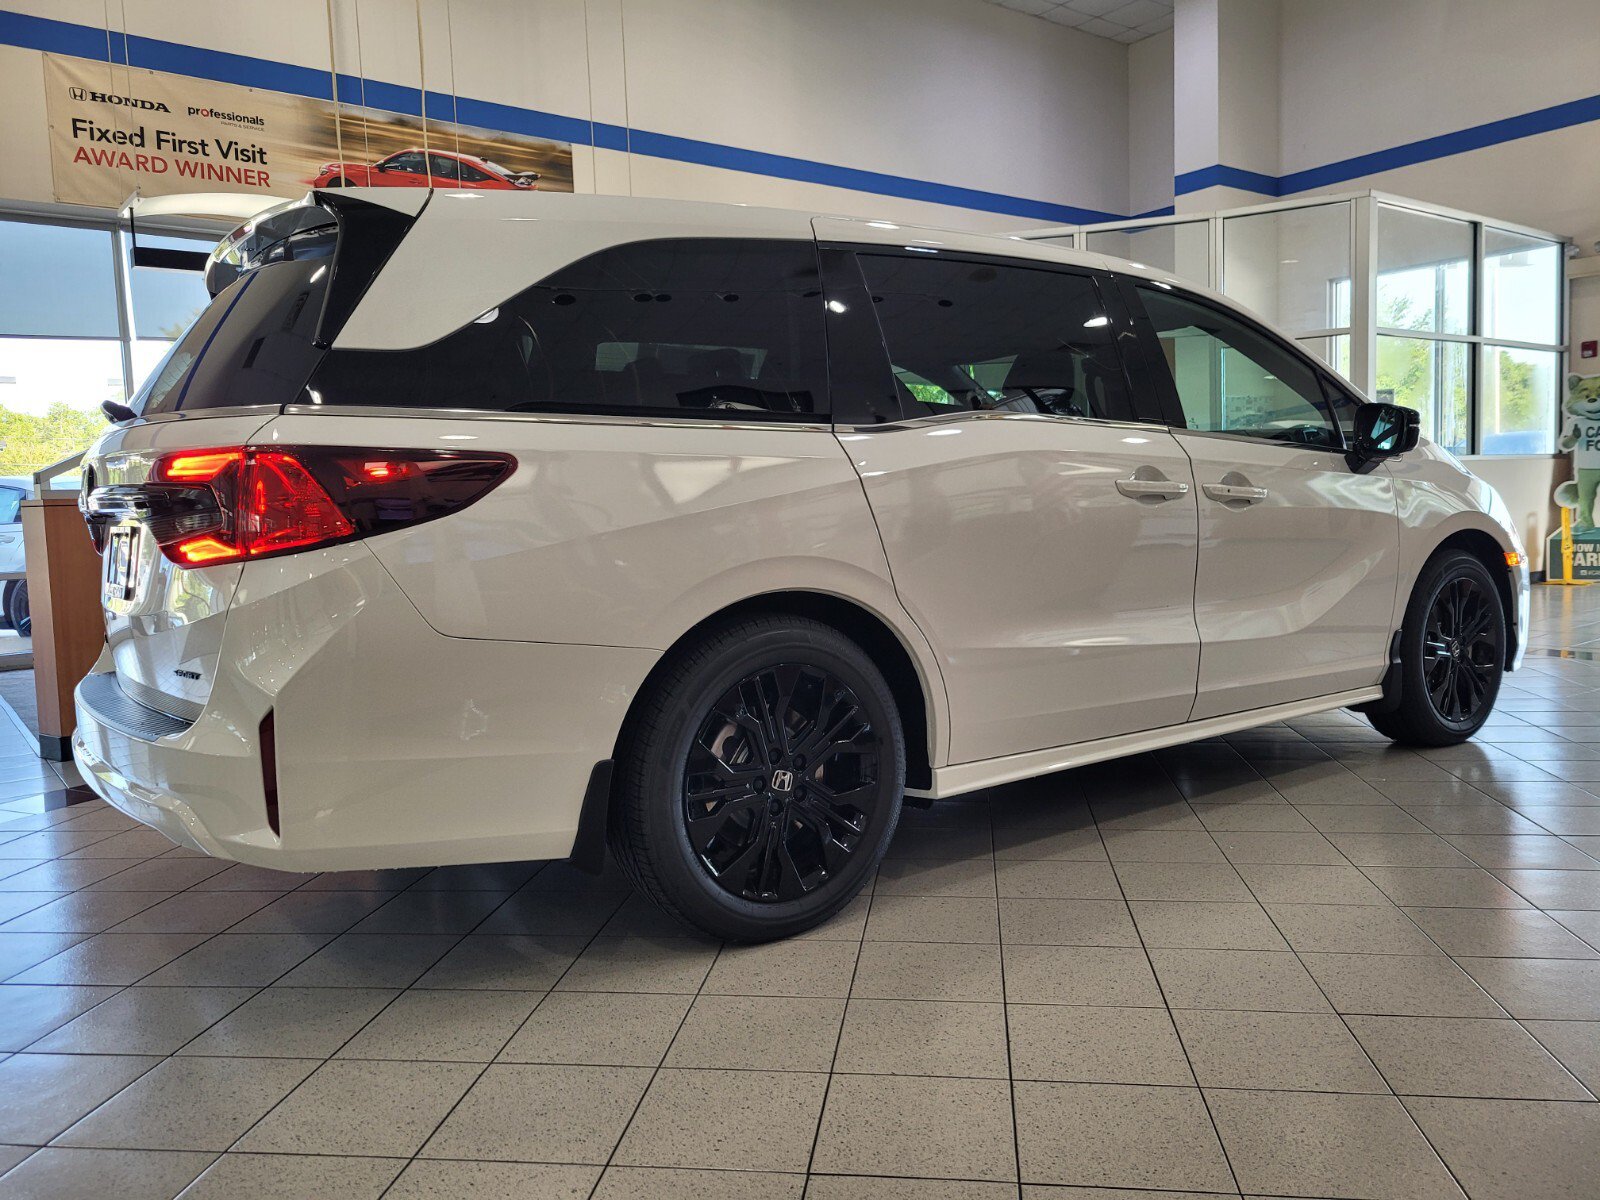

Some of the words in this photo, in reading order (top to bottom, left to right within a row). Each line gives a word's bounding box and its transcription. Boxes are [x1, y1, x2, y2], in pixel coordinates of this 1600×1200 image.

[89, 92, 171, 113] HONDA
[188, 106, 265, 126] professionals
[72, 118, 145, 148] Fixed
[156, 130, 210, 157] First
[214, 139, 268, 165] Visit
[73, 146, 168, 173] AWARD
[174, 159, 271, 187] WINNER
